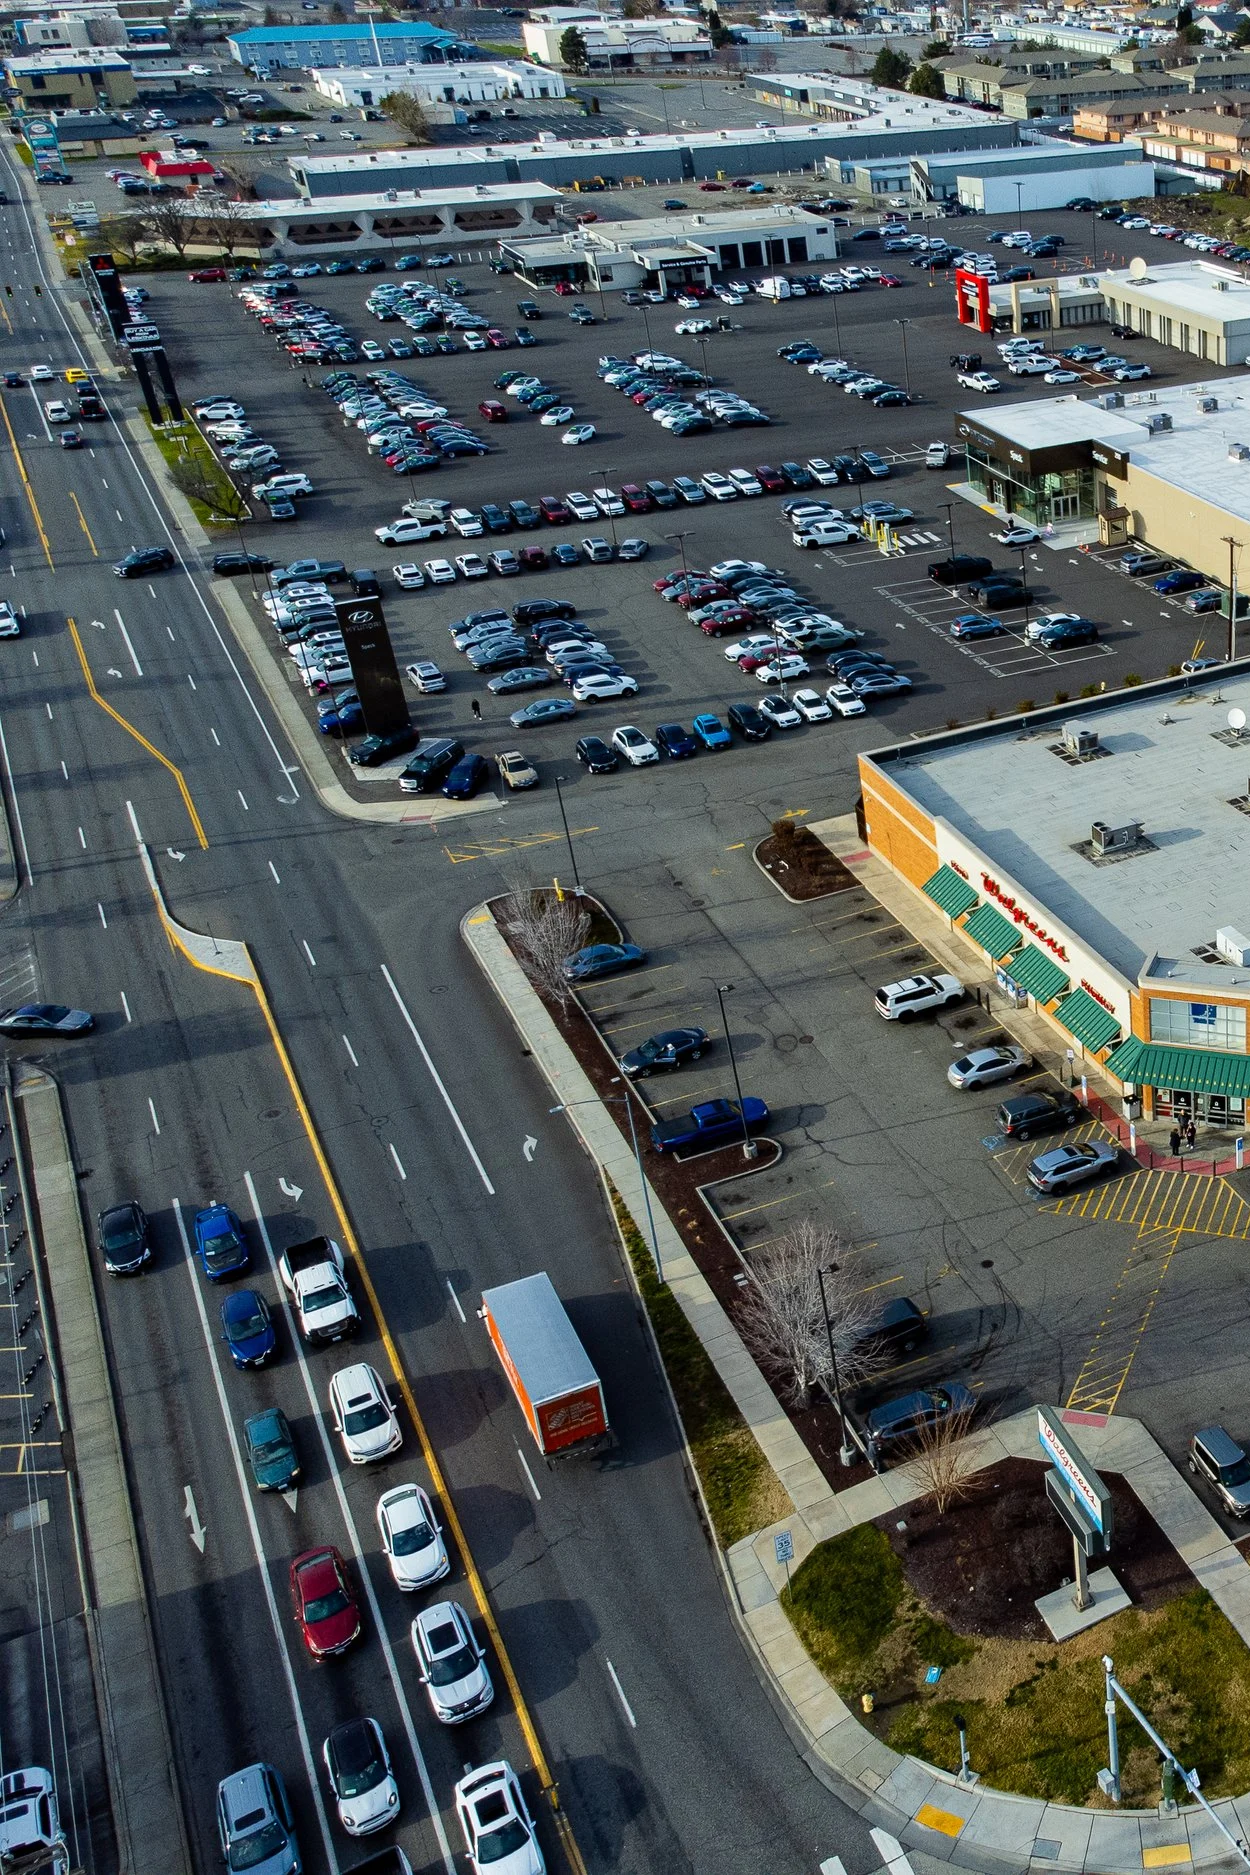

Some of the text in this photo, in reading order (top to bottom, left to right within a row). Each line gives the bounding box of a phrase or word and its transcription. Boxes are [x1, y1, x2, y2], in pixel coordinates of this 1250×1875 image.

[345, 620, 382, 633] HYUNDAI
[980, 872, 1070, 963] Walgreens
[1043, 1419, 1097, 1508] Walgreens
[778, 1540, 791, 1550] 35
